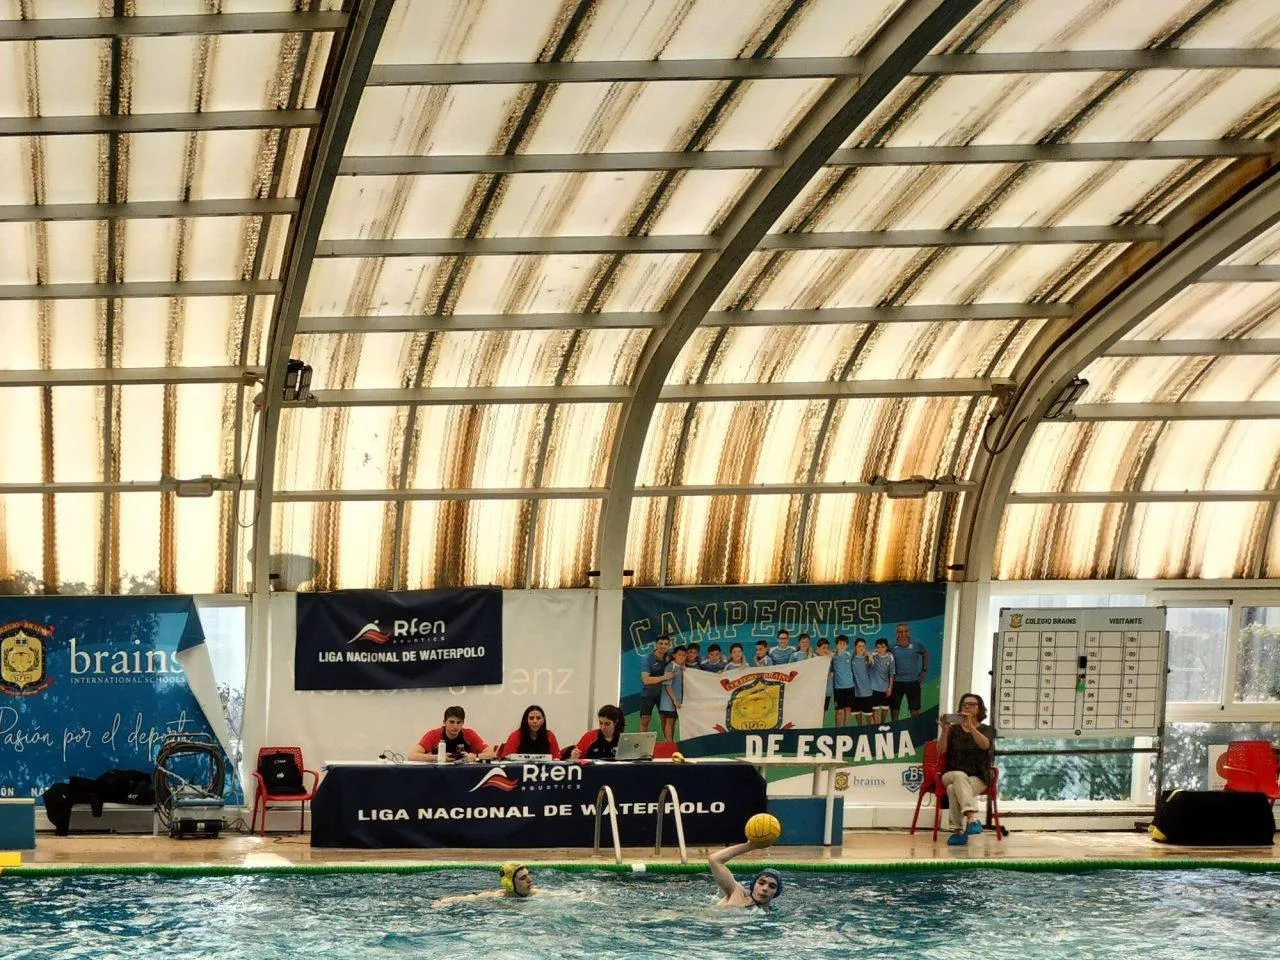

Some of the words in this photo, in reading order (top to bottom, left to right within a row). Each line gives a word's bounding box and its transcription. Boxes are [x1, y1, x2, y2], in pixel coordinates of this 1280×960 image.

[393, 617, 446, 637] Rfen
[629, 597, 882, 657] CAMPEONES
[68, 637, 186, 675] brains
[319, 651, 343, 662] LIGA
[346, 650, 399, 662] NACIONAL
[402, 650, 417, 662] DE
[420, 646, 485, 661] WATERPOLO
[70, 677, 142, 685] INTERNATIONAL
[145, 676, 186, 684] SCHOOLS
[63, 727, 92, 762] por
[101, 712, 121, 750] el
[745, 734, 784, 759] DE
[797, 725, 916, 761] ESPAÑA
[853, 775, 886, 787] brains
[357, 807, 410, 821] LIGA
[417, 805, 536, 821] NACIONAL
[544, 804, 573, 817] DE
